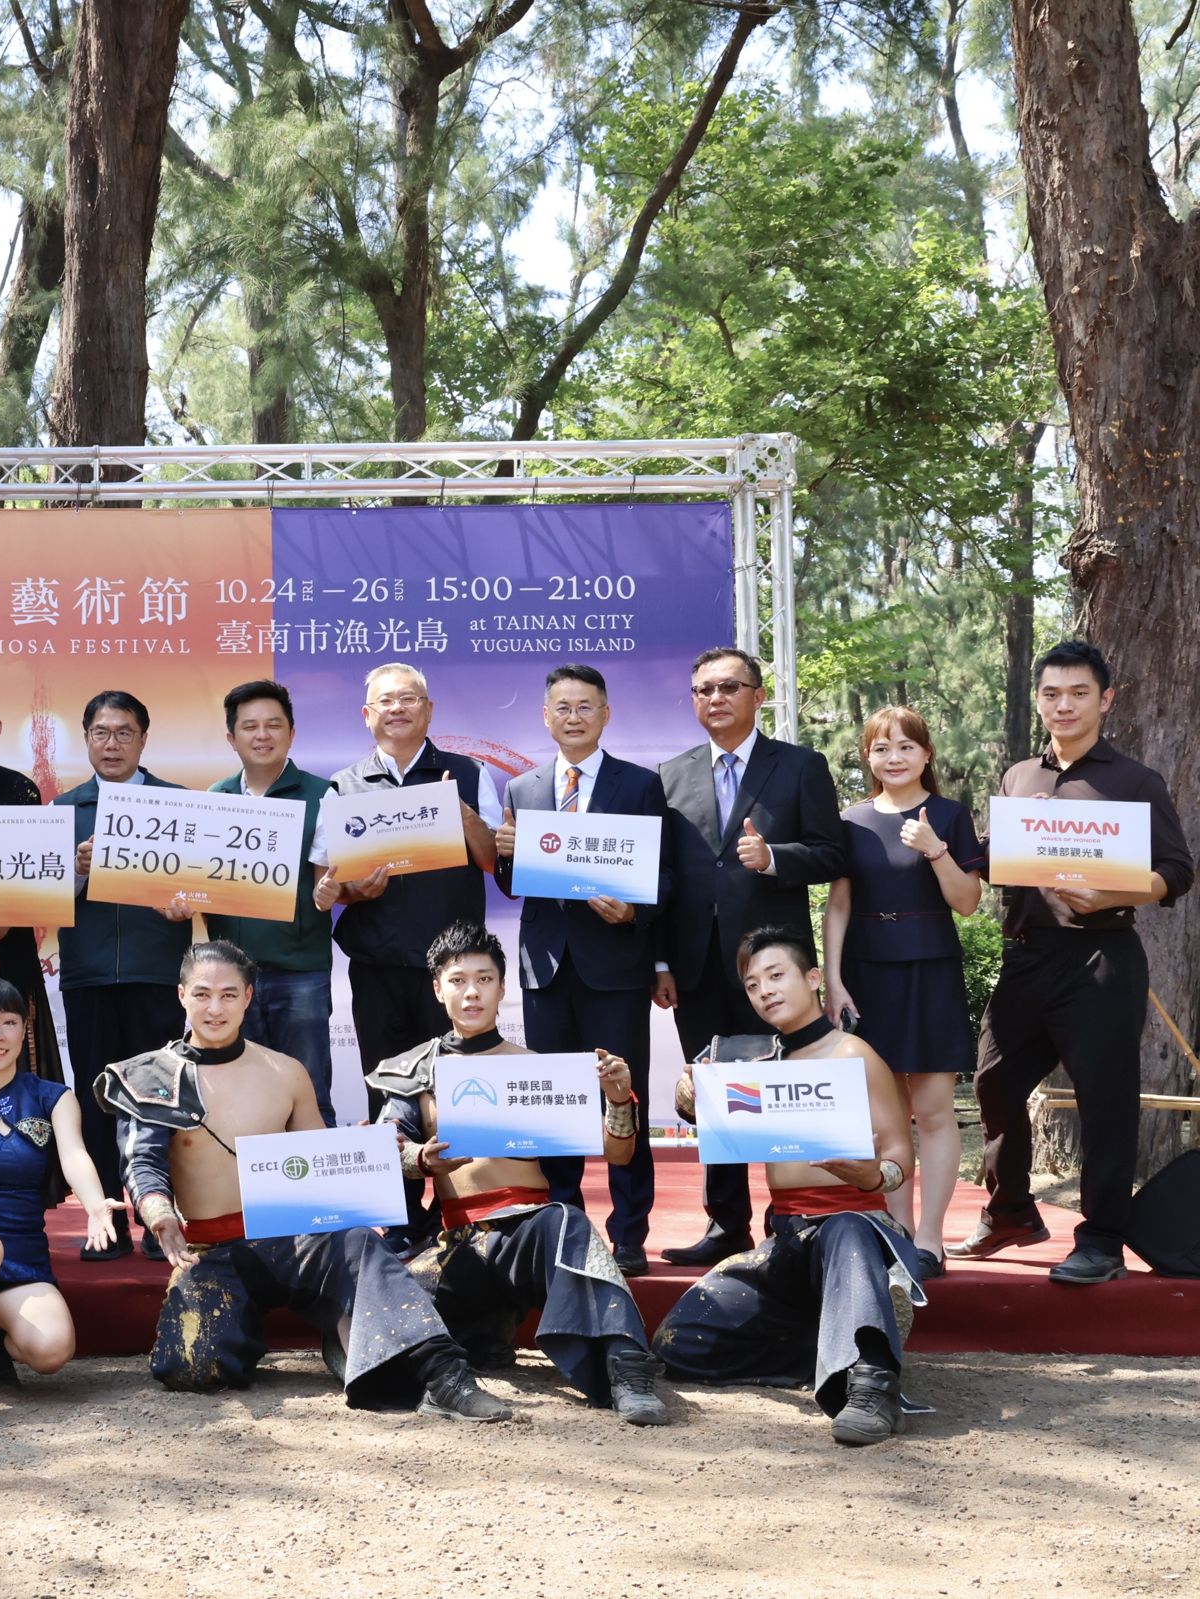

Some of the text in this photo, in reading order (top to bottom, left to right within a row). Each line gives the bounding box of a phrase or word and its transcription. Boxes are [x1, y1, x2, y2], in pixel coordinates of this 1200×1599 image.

[215, 577, 296, 604] 10.24
[302, 580, 314, 602] FRI
[352, 577, 388, 603] 26
[394, 578, 404, 601] SUN
[426, 575, 513, 602] 15:00
[548, 575, 636, 601] 21:00
[470, 614, 635, 631] at TAINAN CITY
[215, 617, 449, 655] 臺南市漁光島
[470, 637, 636, 653] YUGUANG ISLAND
[71, 637, 190, 655] FESTIVAL
[369, 806, 439, 828] 文化部
[102, 813, 179, 842] 10.24
[184, 822, 196, 843] FRI
[226, 825, 261, 850] 26
[268, 830, 278, 852] SUN
[1020, 818, 1120, 836] TAIWAN
[567, 836, 636, 854] 永豐銀行
[1036, 846, 1104, 859] 交通部觀光署
[99, 846, 181, 875] 15:00
[207, 857, 290, 886] 21:00
[566, 854, 634, 866] Bank SinoPac
[507, 1080, 553, 1091] 中華民國
[765, 1082, 834, 1101] TIPC
[507, 1093, 588, 1107] 尹老師傳愛協會
[250, 1161, 278, 1173] CECI
[312, 1151, 366, 1168] 台灣世曦
